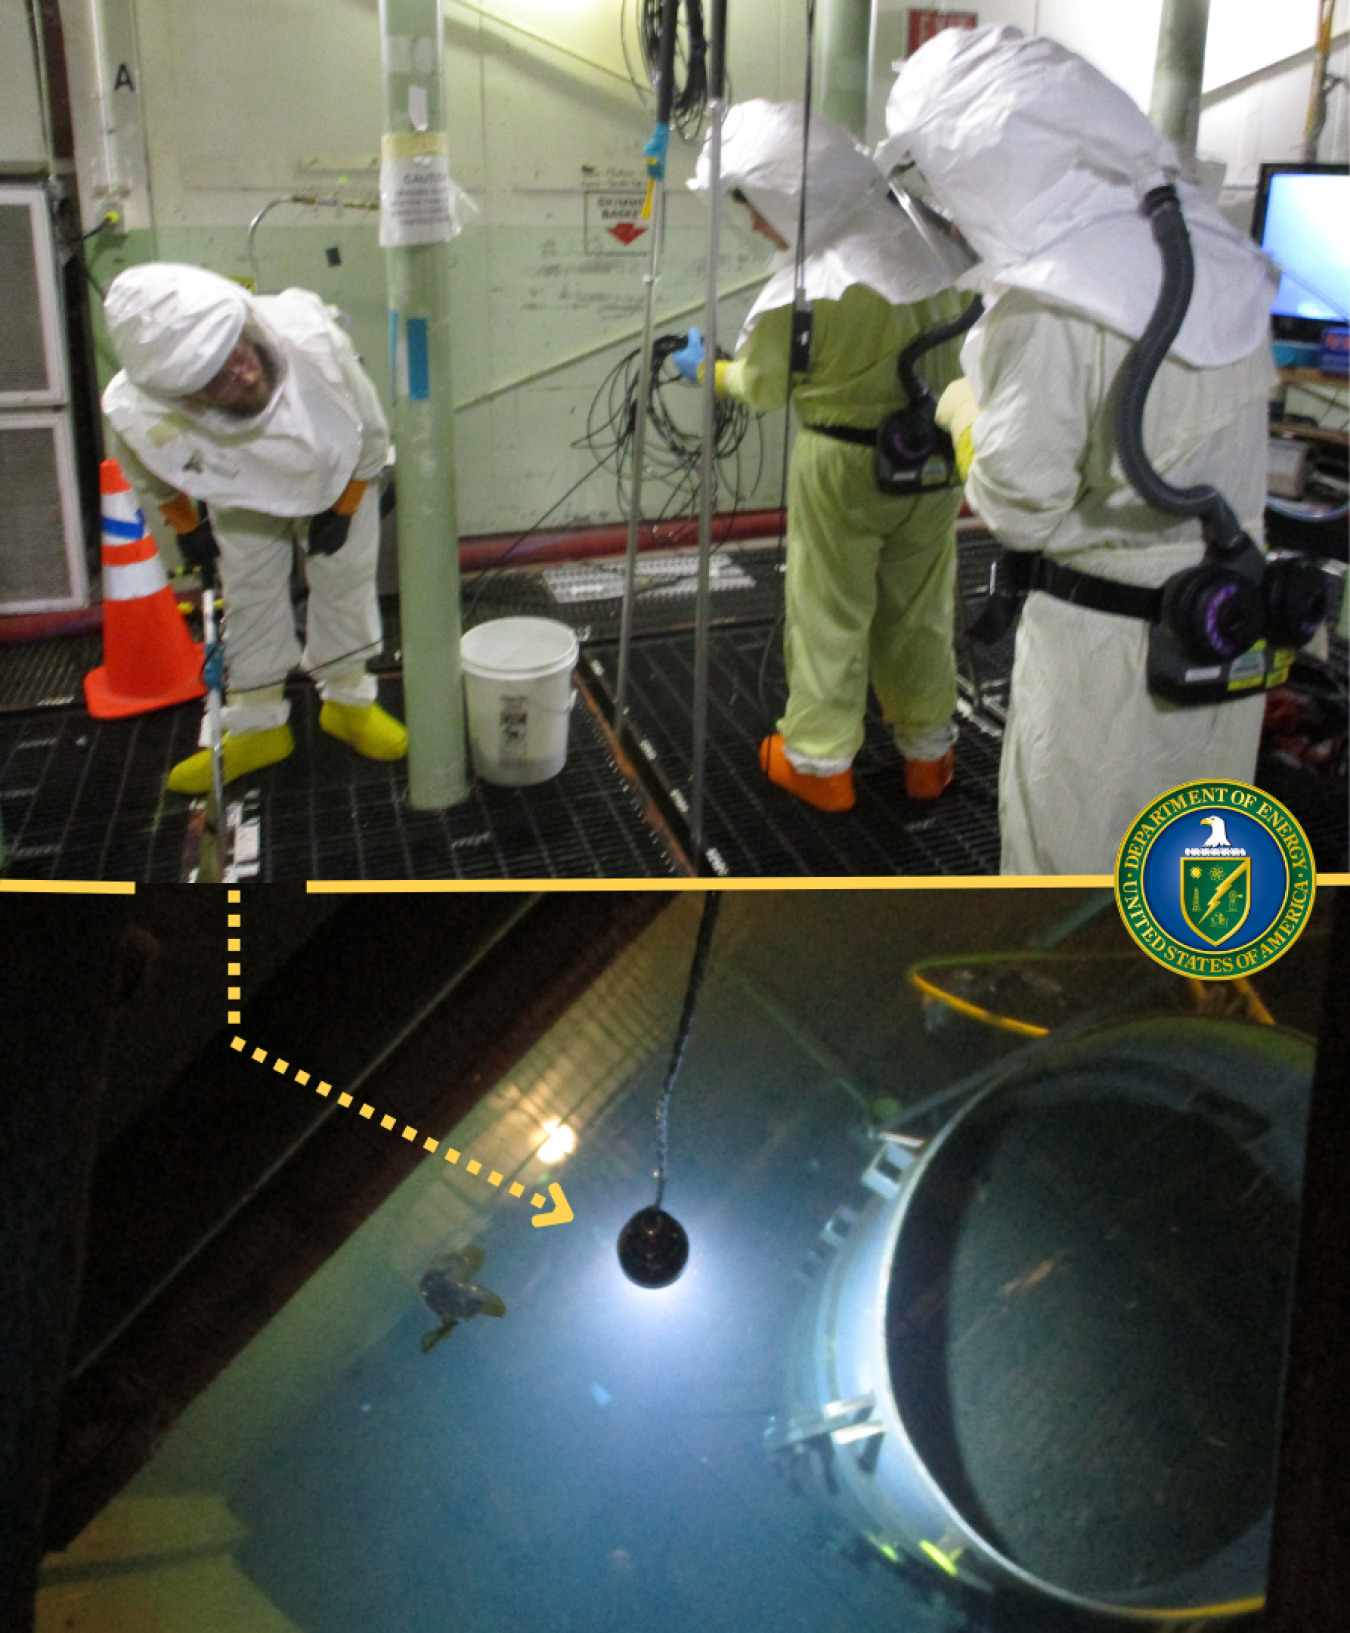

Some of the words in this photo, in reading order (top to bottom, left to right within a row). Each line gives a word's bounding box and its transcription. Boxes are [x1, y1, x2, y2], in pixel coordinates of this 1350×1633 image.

[114, 62, 134, 92] A
[597, 197, 645, 208] SKIMME
[601, 209, 641, 219] BASKE
